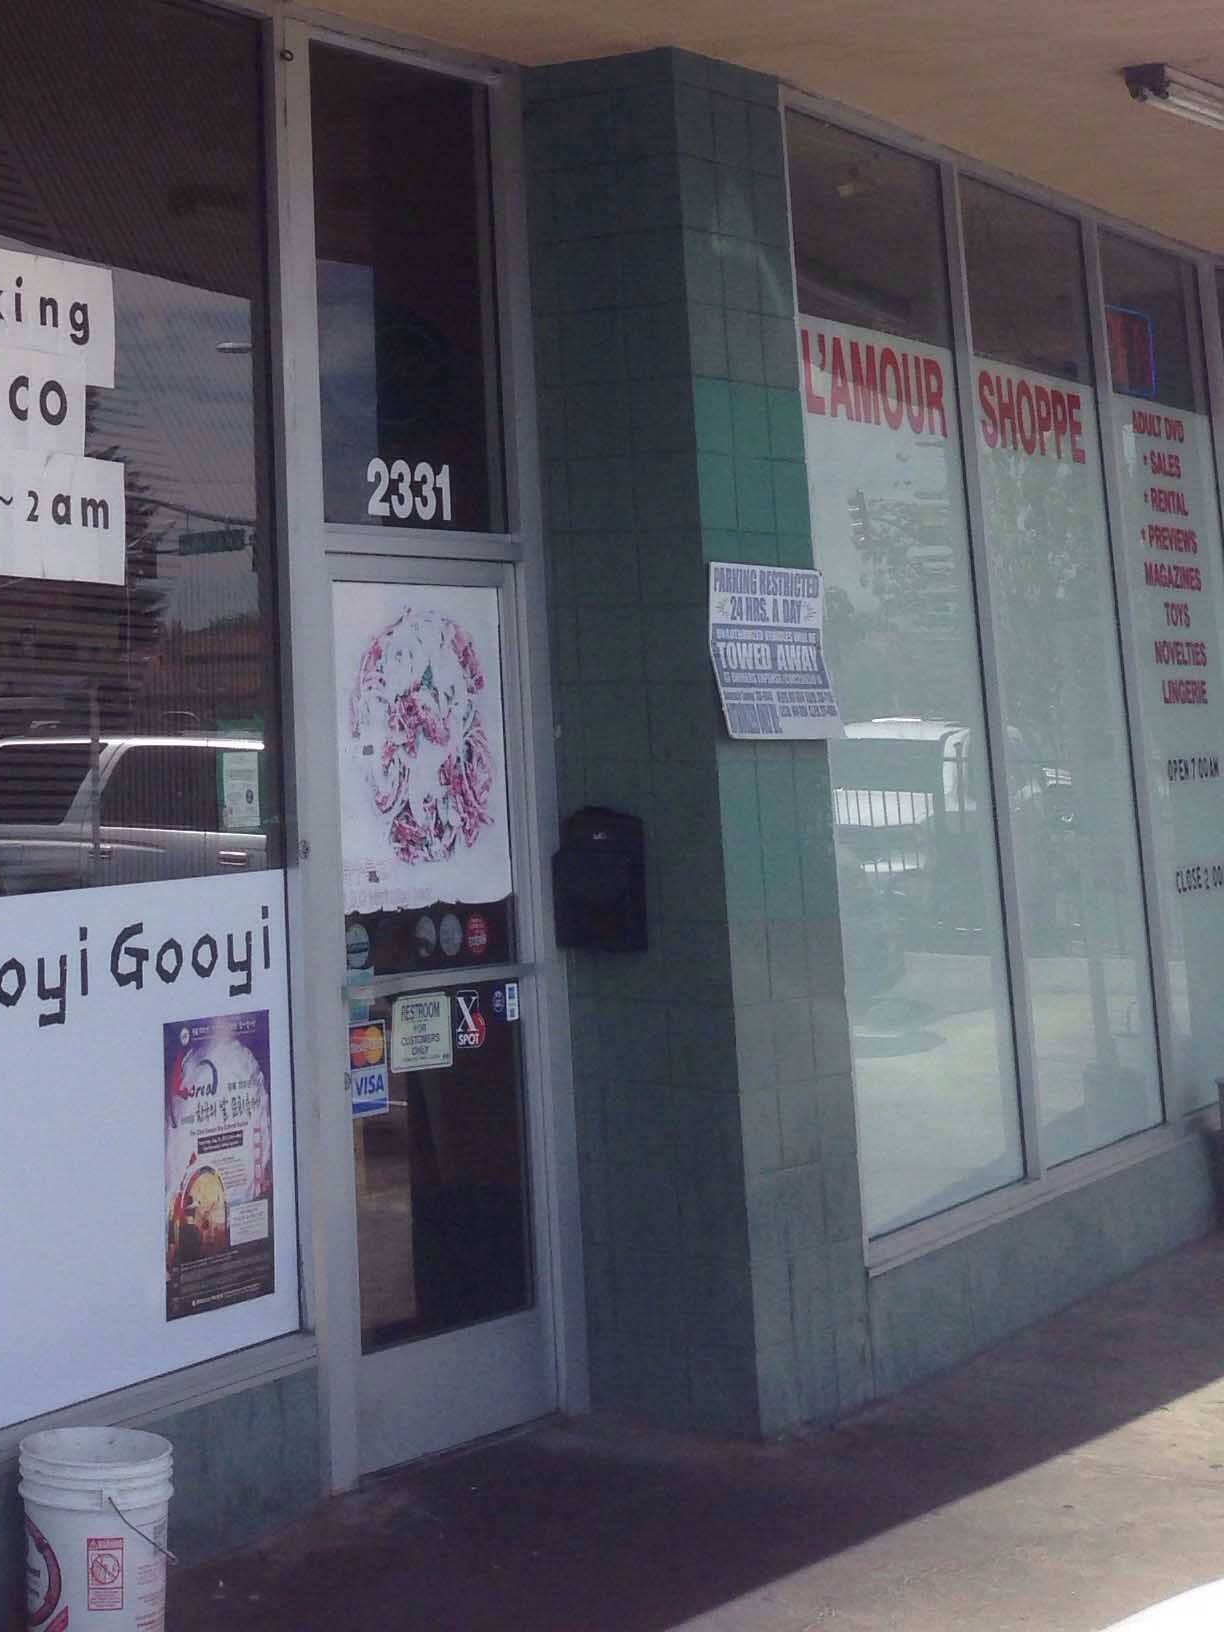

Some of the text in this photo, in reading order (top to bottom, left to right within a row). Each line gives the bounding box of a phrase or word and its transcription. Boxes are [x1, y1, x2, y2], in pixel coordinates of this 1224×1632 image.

[801, 329, 1086, 464] L'AMOUR SHOPPE
[1132, 409, 1163, 439] ADULT
[1150, 449, 1182, 479] SALES
[366, 457, 452, 521] 2331
[1150, 486, 1189, 516] RENTAL
[1147, 524, 1199, 555] PREVIEWS
[713, 568, 820, 599] PARKING RESTRICTED
[1143, 561, 1203, 593] MAGAZINES
[730, 596, 744, 622] 24
[782, 600, 804, 624] DAY
[1164, 601, 1192, 629] TOYS
[717, 642, 819, 671] TOWED AWAY
[1154, 640, 1208, 668] NOVELTIES
[1162, 678, 1209, 705] LINGERIE
[1168, 759, 1190, 781] OPEN
[1176, 866, 1203, 894] CLOSE
[110, 905, 271, 997] Gooyi
[401, 1002, 440, 1021] RESTROOM
[456, 996, 477, 1032] X
[458, 1032, 480, 1046] SPOT
[355, 1073, 385, 1096] VISA
